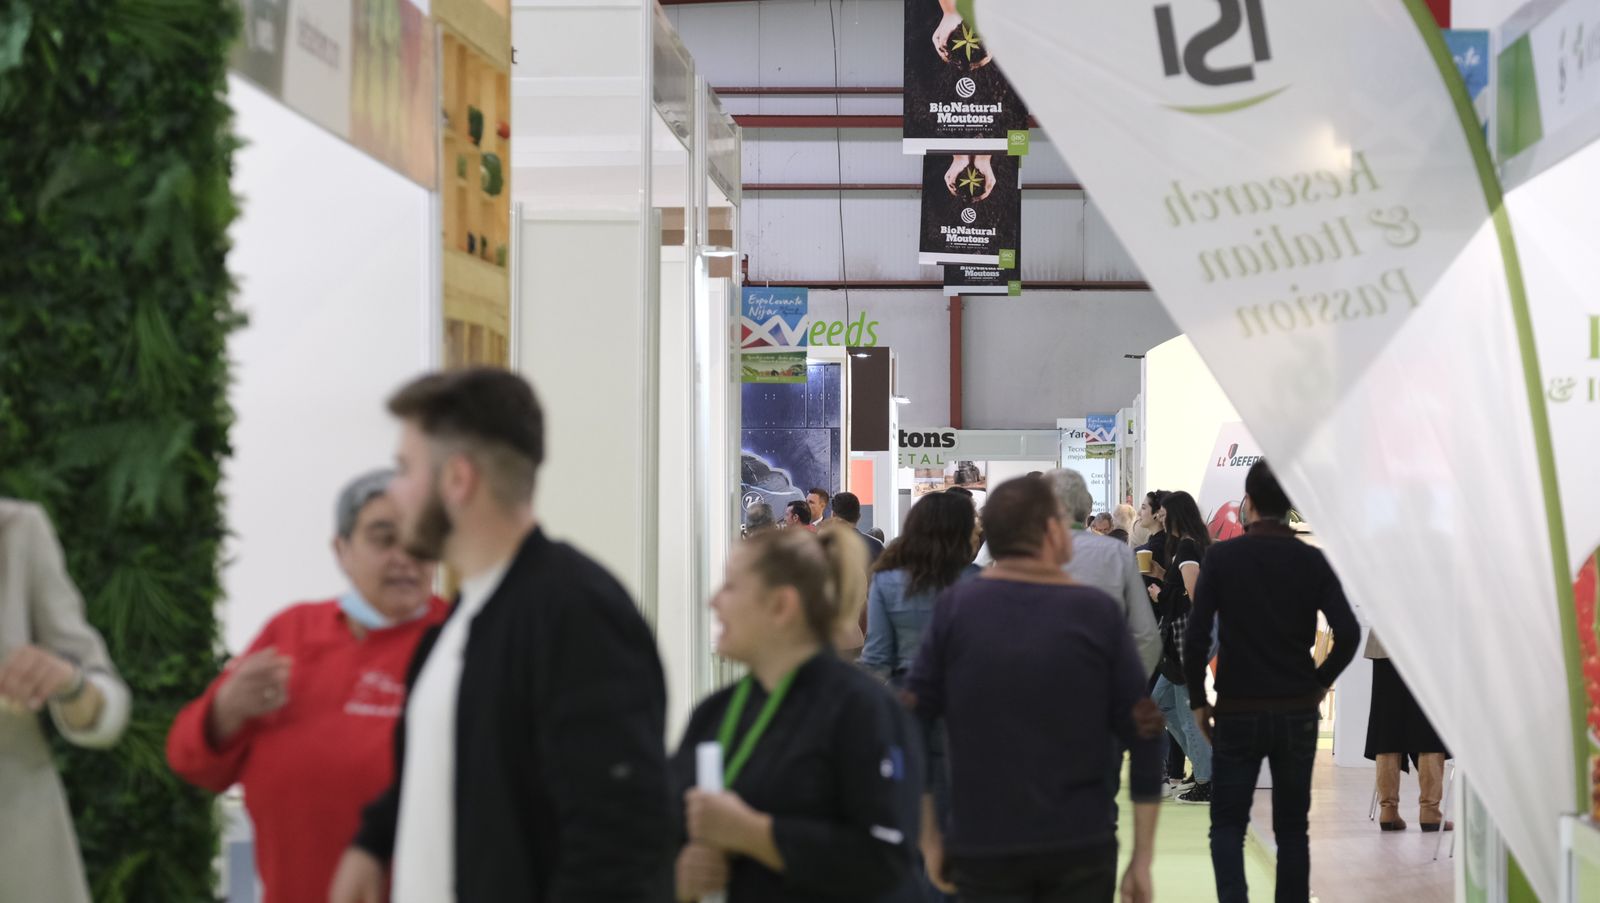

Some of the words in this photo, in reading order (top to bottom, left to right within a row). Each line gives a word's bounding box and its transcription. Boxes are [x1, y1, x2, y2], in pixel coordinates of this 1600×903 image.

[929, 102, 1003, 113] BioNatural
[937, 112, 994, 124] Moutons
[940, 225, 996, 236] BioNatural
[945, 233, 990, 244] Moutons
